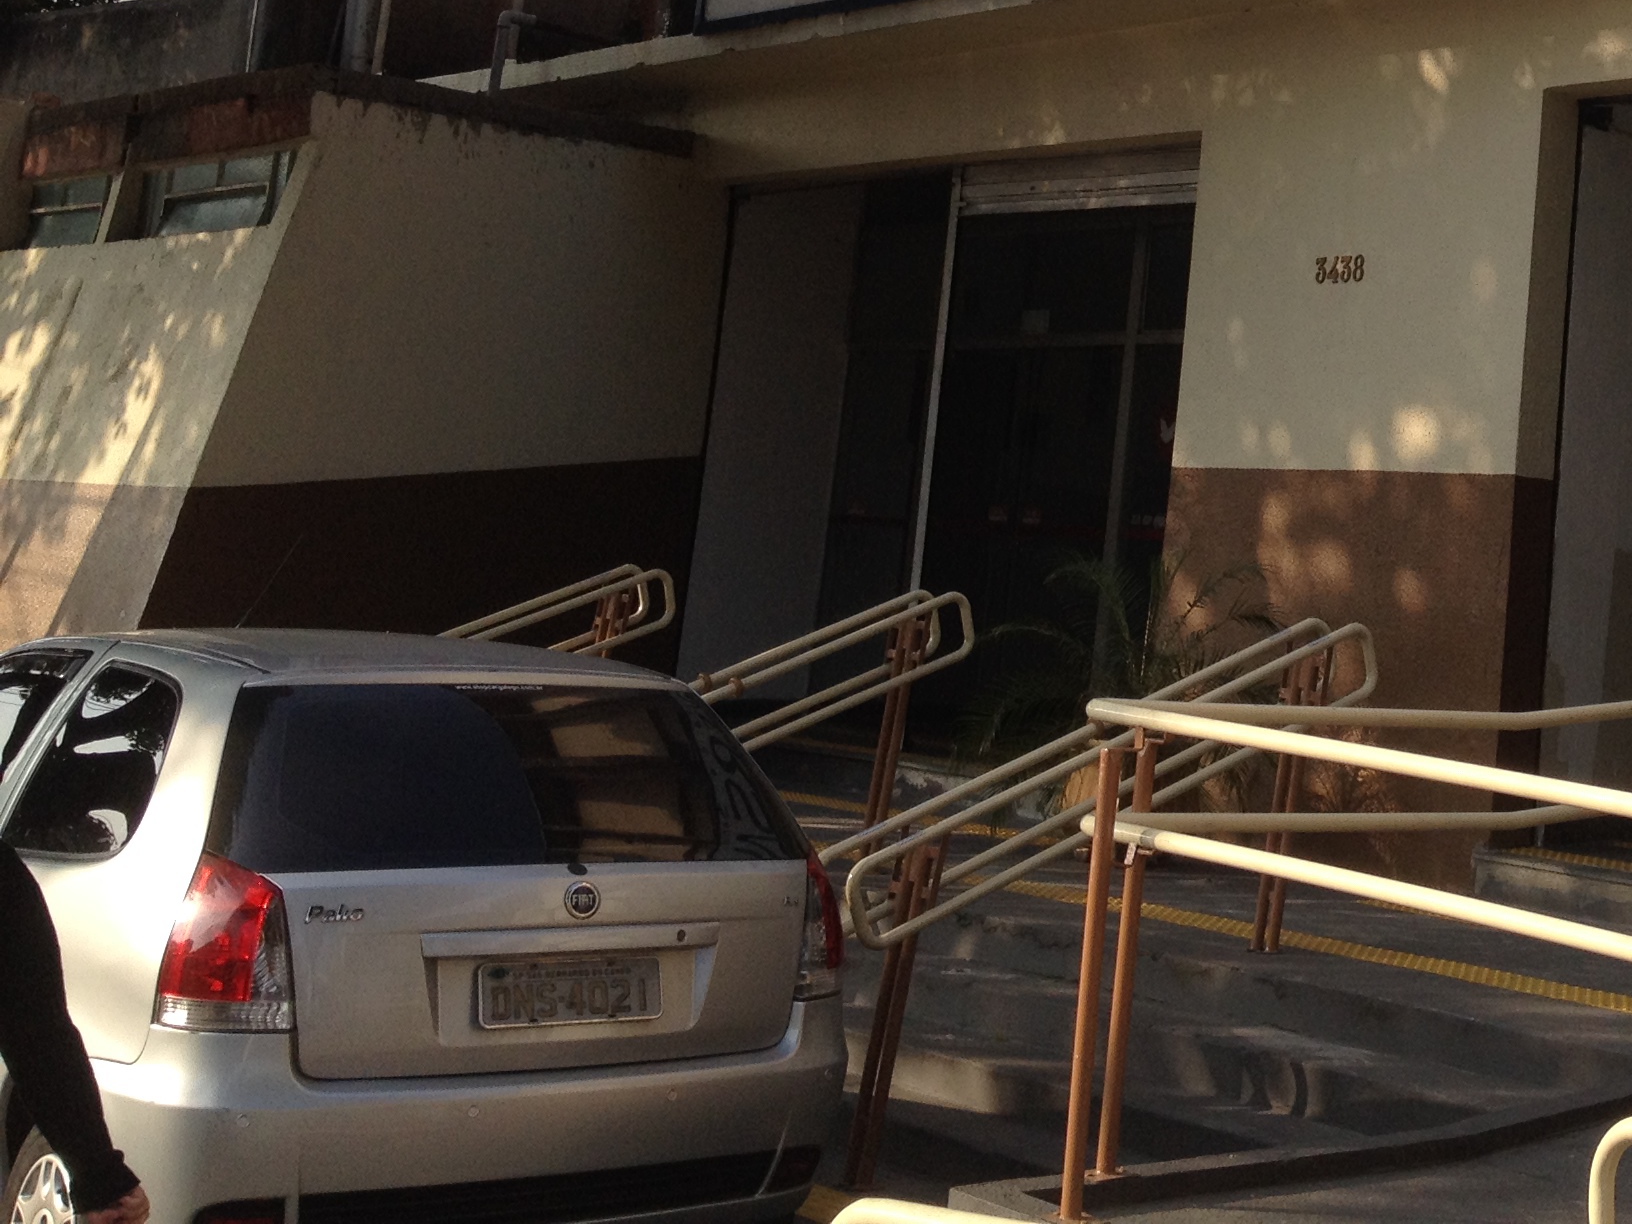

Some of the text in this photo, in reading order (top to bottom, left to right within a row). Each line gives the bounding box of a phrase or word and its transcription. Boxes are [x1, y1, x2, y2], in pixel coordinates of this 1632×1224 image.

[1314, 253, 1366, 285] 3438
[572, 893, 595, 906] FIAT
[304, 903, 365, 925] Palio
